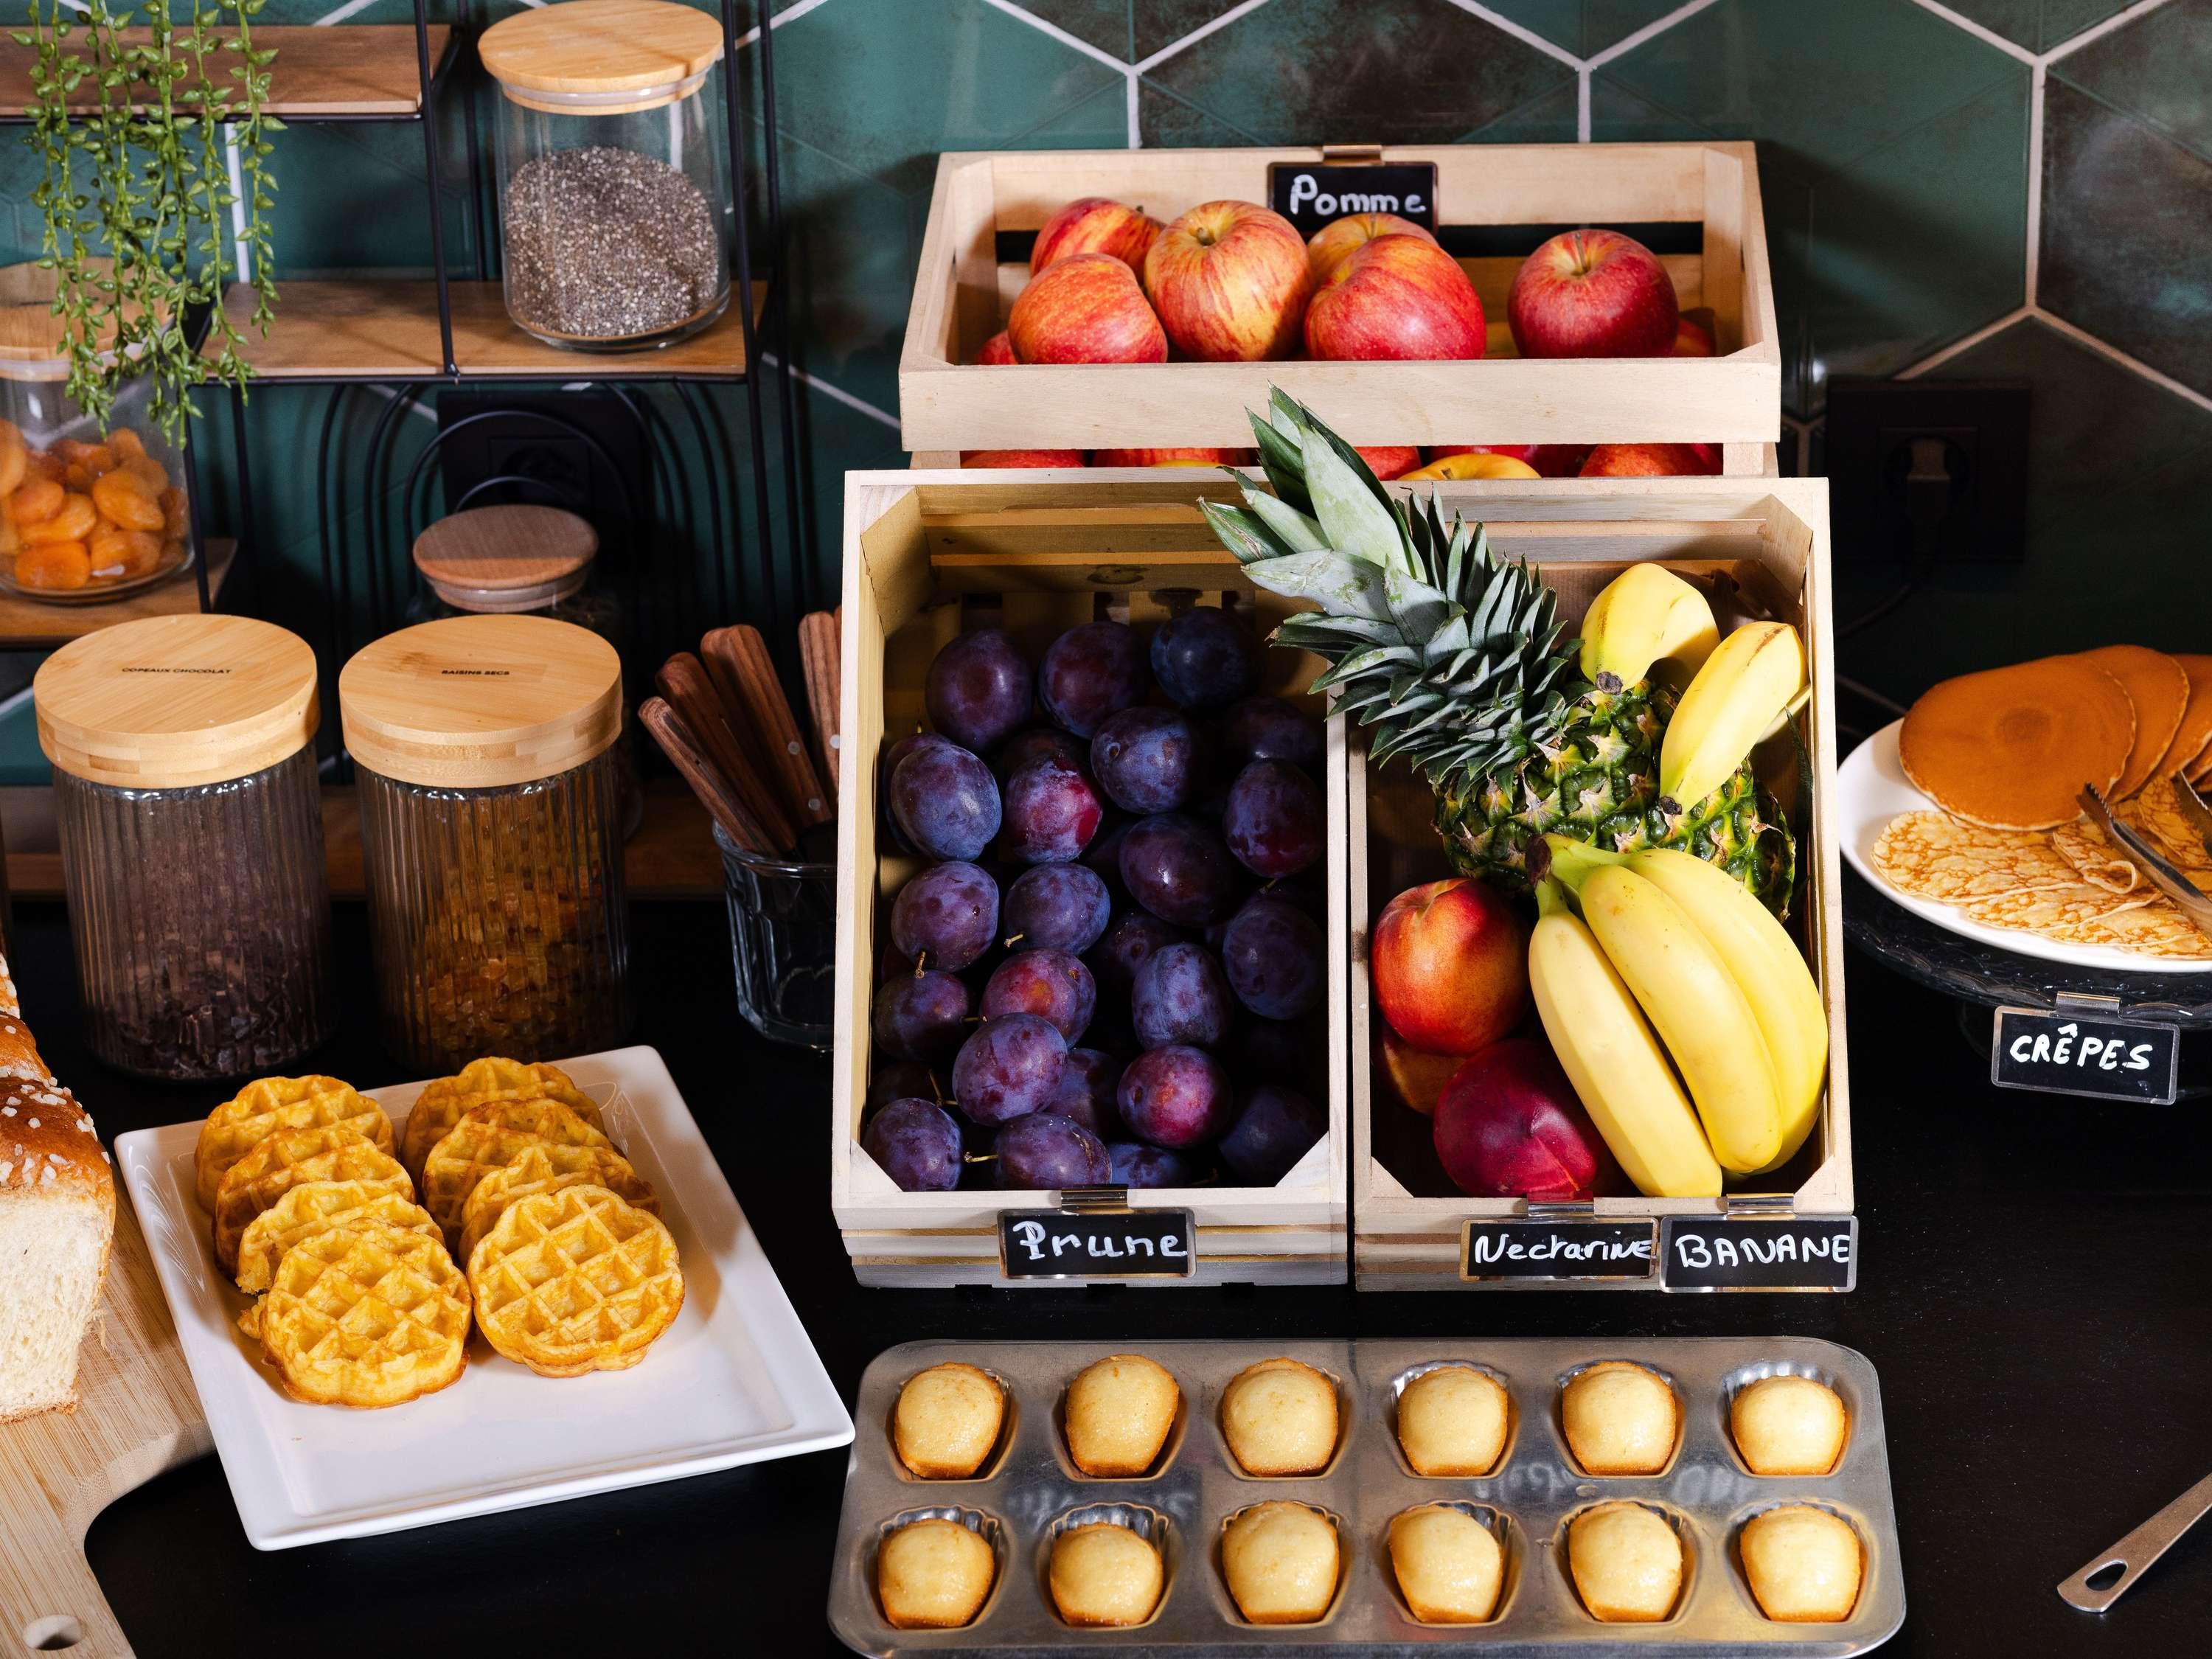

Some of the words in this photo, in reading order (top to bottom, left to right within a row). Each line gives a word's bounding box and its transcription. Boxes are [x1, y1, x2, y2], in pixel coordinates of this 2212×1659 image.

[1290, 174, 1426, 215] Pomme
[2010, 1023, 2153, 1070] CRÊPES
[1012, 1220, 1188, 1260] Prune
[1675, 1234, 1851, 1268] BANANE
